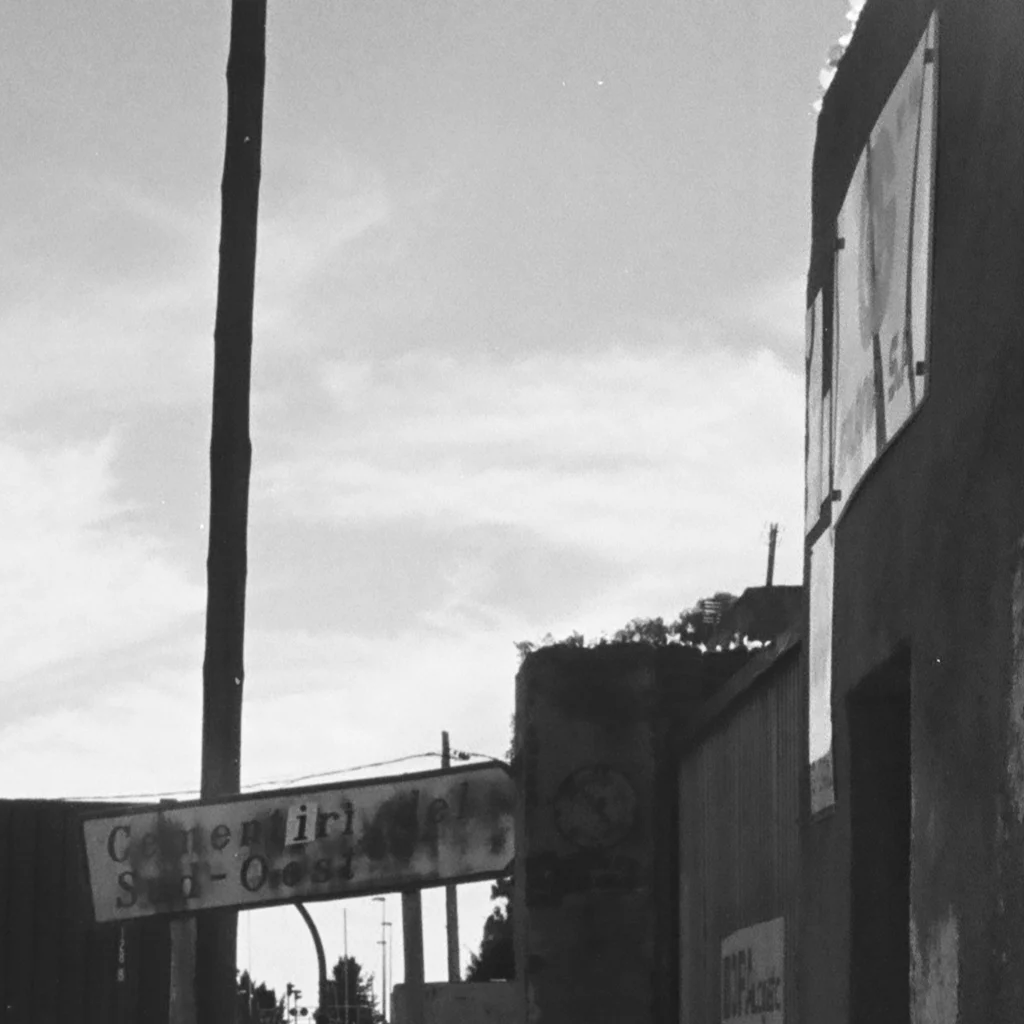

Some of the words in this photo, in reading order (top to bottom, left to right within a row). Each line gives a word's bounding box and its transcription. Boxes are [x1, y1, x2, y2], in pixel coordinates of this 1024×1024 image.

[108, 801, 354, 863] Cemeniri
[395, 781, 470, 828] el
[115, 847, 356, 909] Sd-Oest
